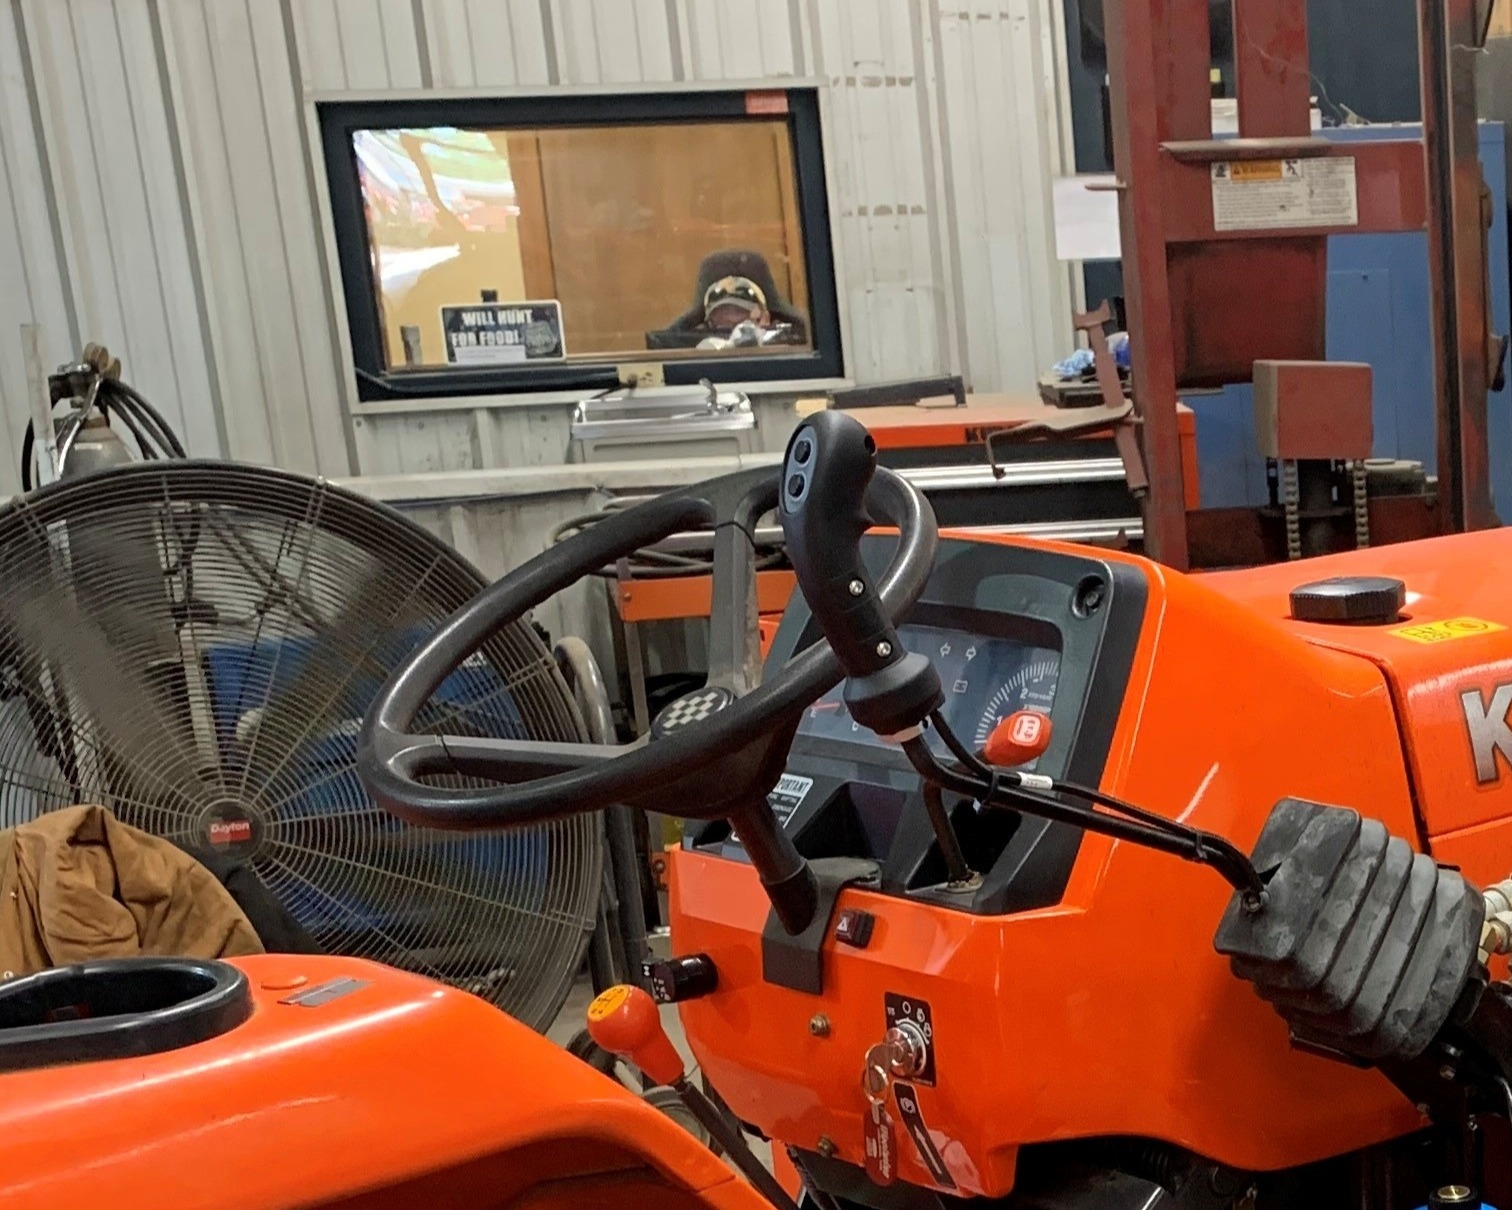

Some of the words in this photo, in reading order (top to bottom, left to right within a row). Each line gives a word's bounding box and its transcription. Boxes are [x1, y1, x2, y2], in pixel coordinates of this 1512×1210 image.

[462, 310, 496, 327] WILL
[497, 308, 533, 325] HUNT
[451, 331, 478, 347] FOR
[479, 329, 520, 346] FOOD!
[211, 822, 250, 833] Dayton
